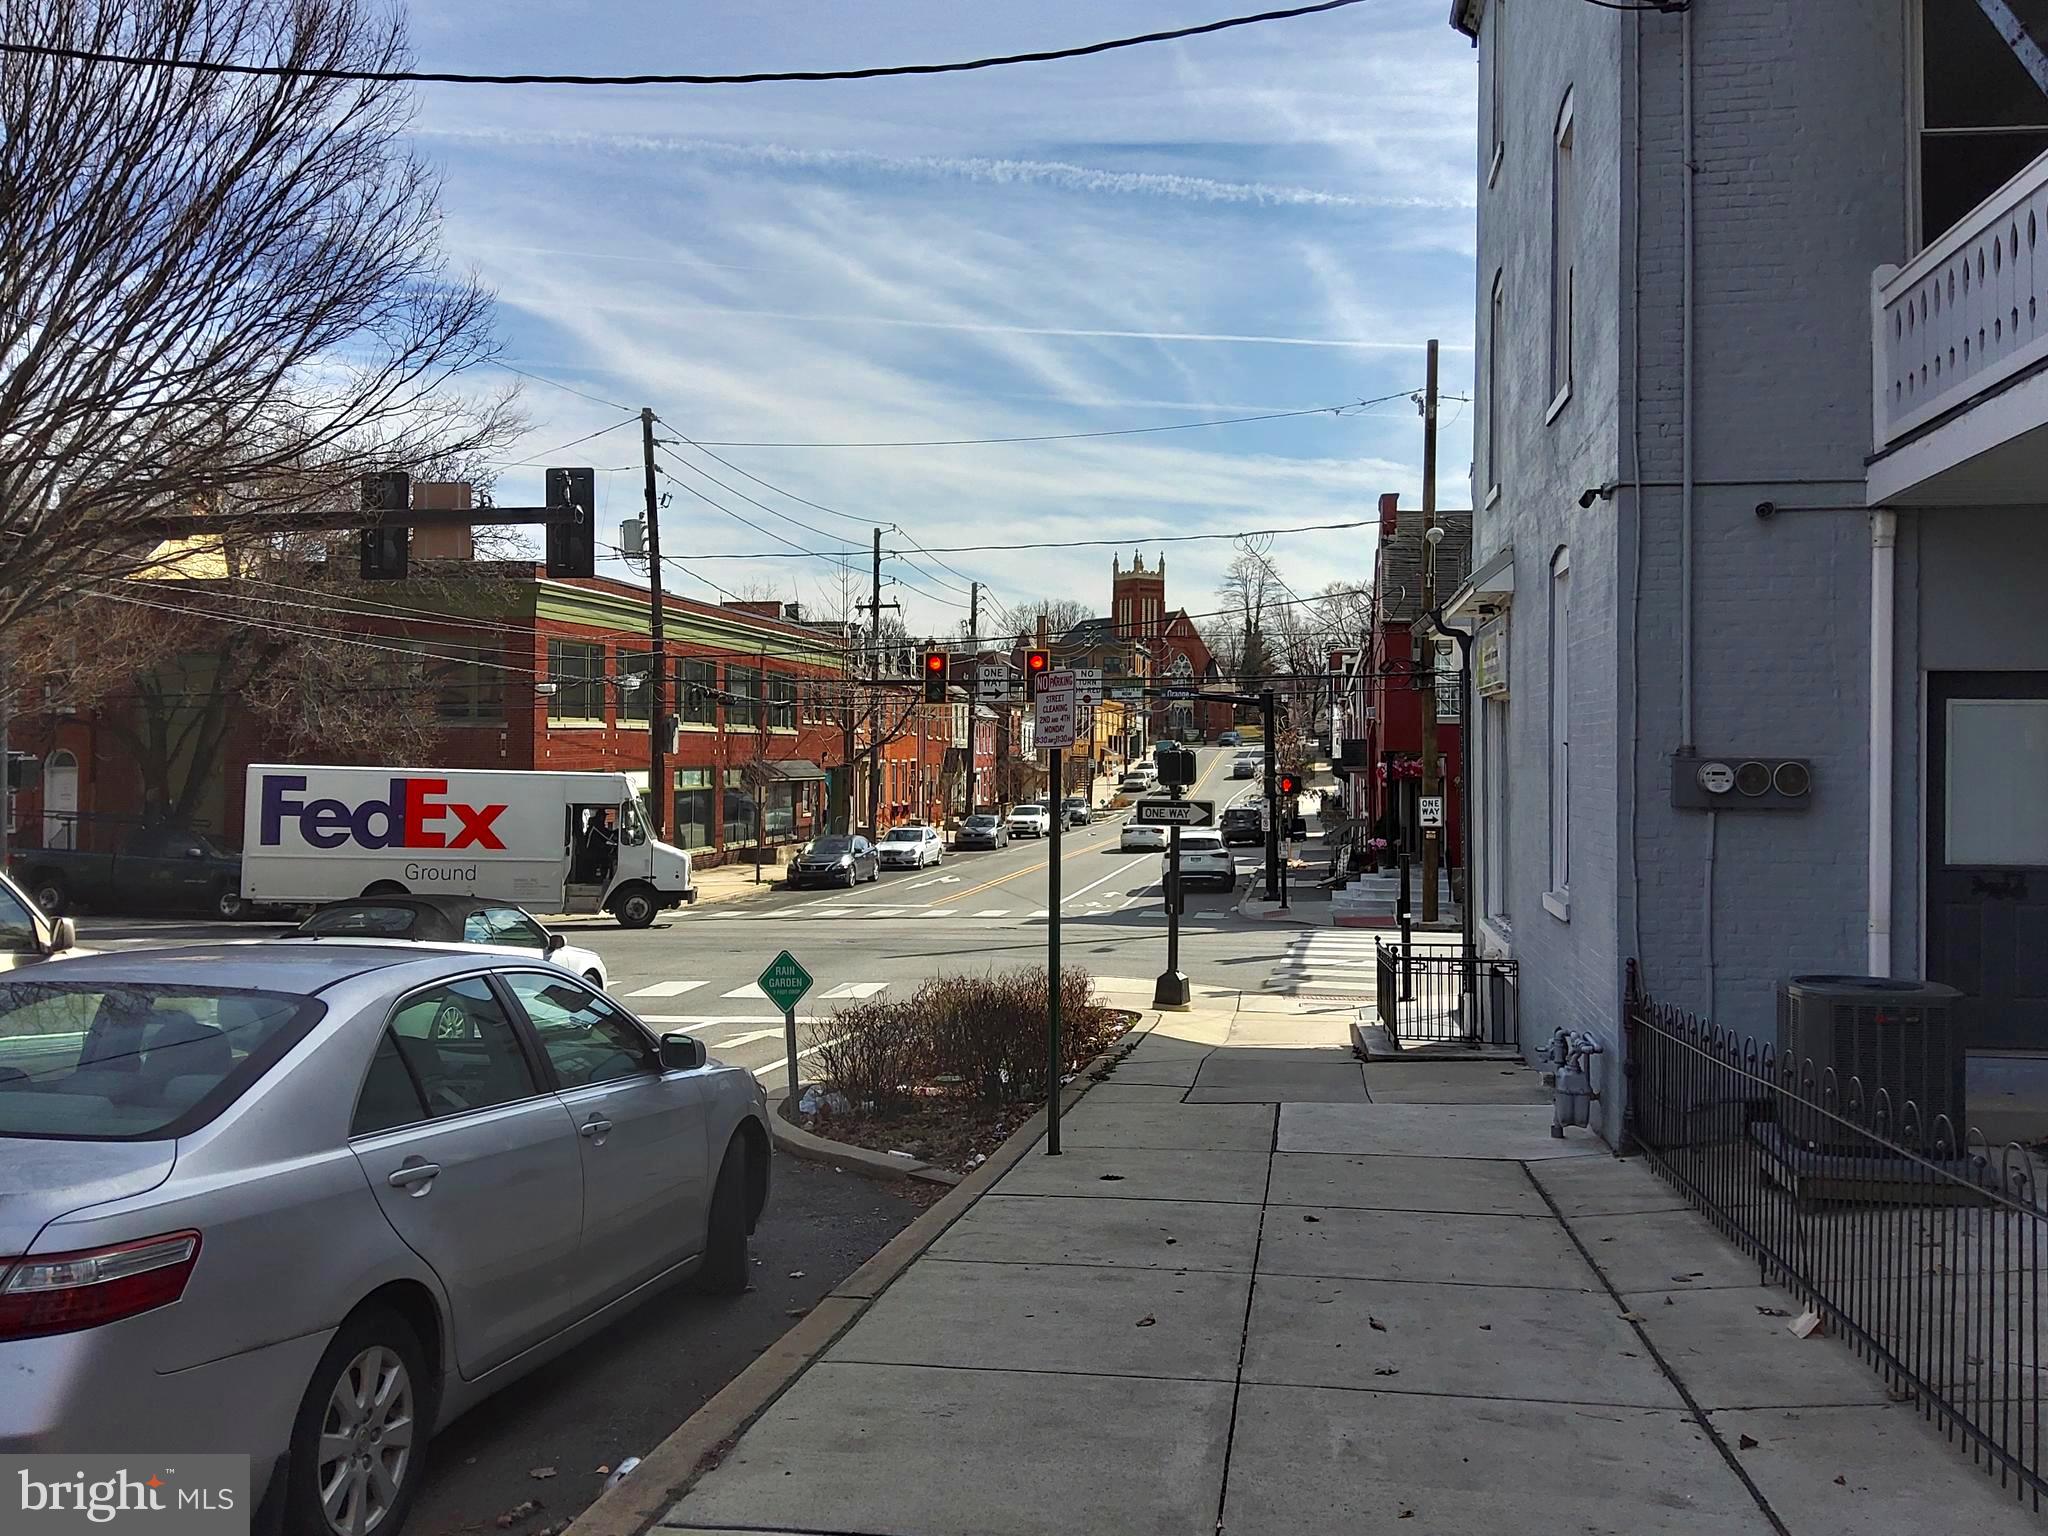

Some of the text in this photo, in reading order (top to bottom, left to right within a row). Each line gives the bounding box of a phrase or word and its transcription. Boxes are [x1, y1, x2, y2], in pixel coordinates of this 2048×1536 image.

[984, 668, 1003, 677] ONE
[1081, 670, 1094, 678] NO
[984, 678, 1002, 687] WAY
[1037, 675, 1073, 692] NO PARKING
[1079, 678, 1097, 686] TURN
[1046, 694, 1065, 704] STREET
[1043, 704, 1068, 714] CLEANING
[1039, 716, 1050, 724] 2ND
[1060, 714, 1071, 722] 4TH
[1044, 725, 1065, 733] MONDAY
[1422, 799, 1440, 808] ONE
[260, 775, 509, 851] FedEx
[1145, 808, 1190, 818] ONE WAY
[1422, 807, 1440, 816] WAY
[405, 863, 477, 883] Ground
[776, 966, 794, 976] RAIN
[769, 978, 802, 987] GARDEN
